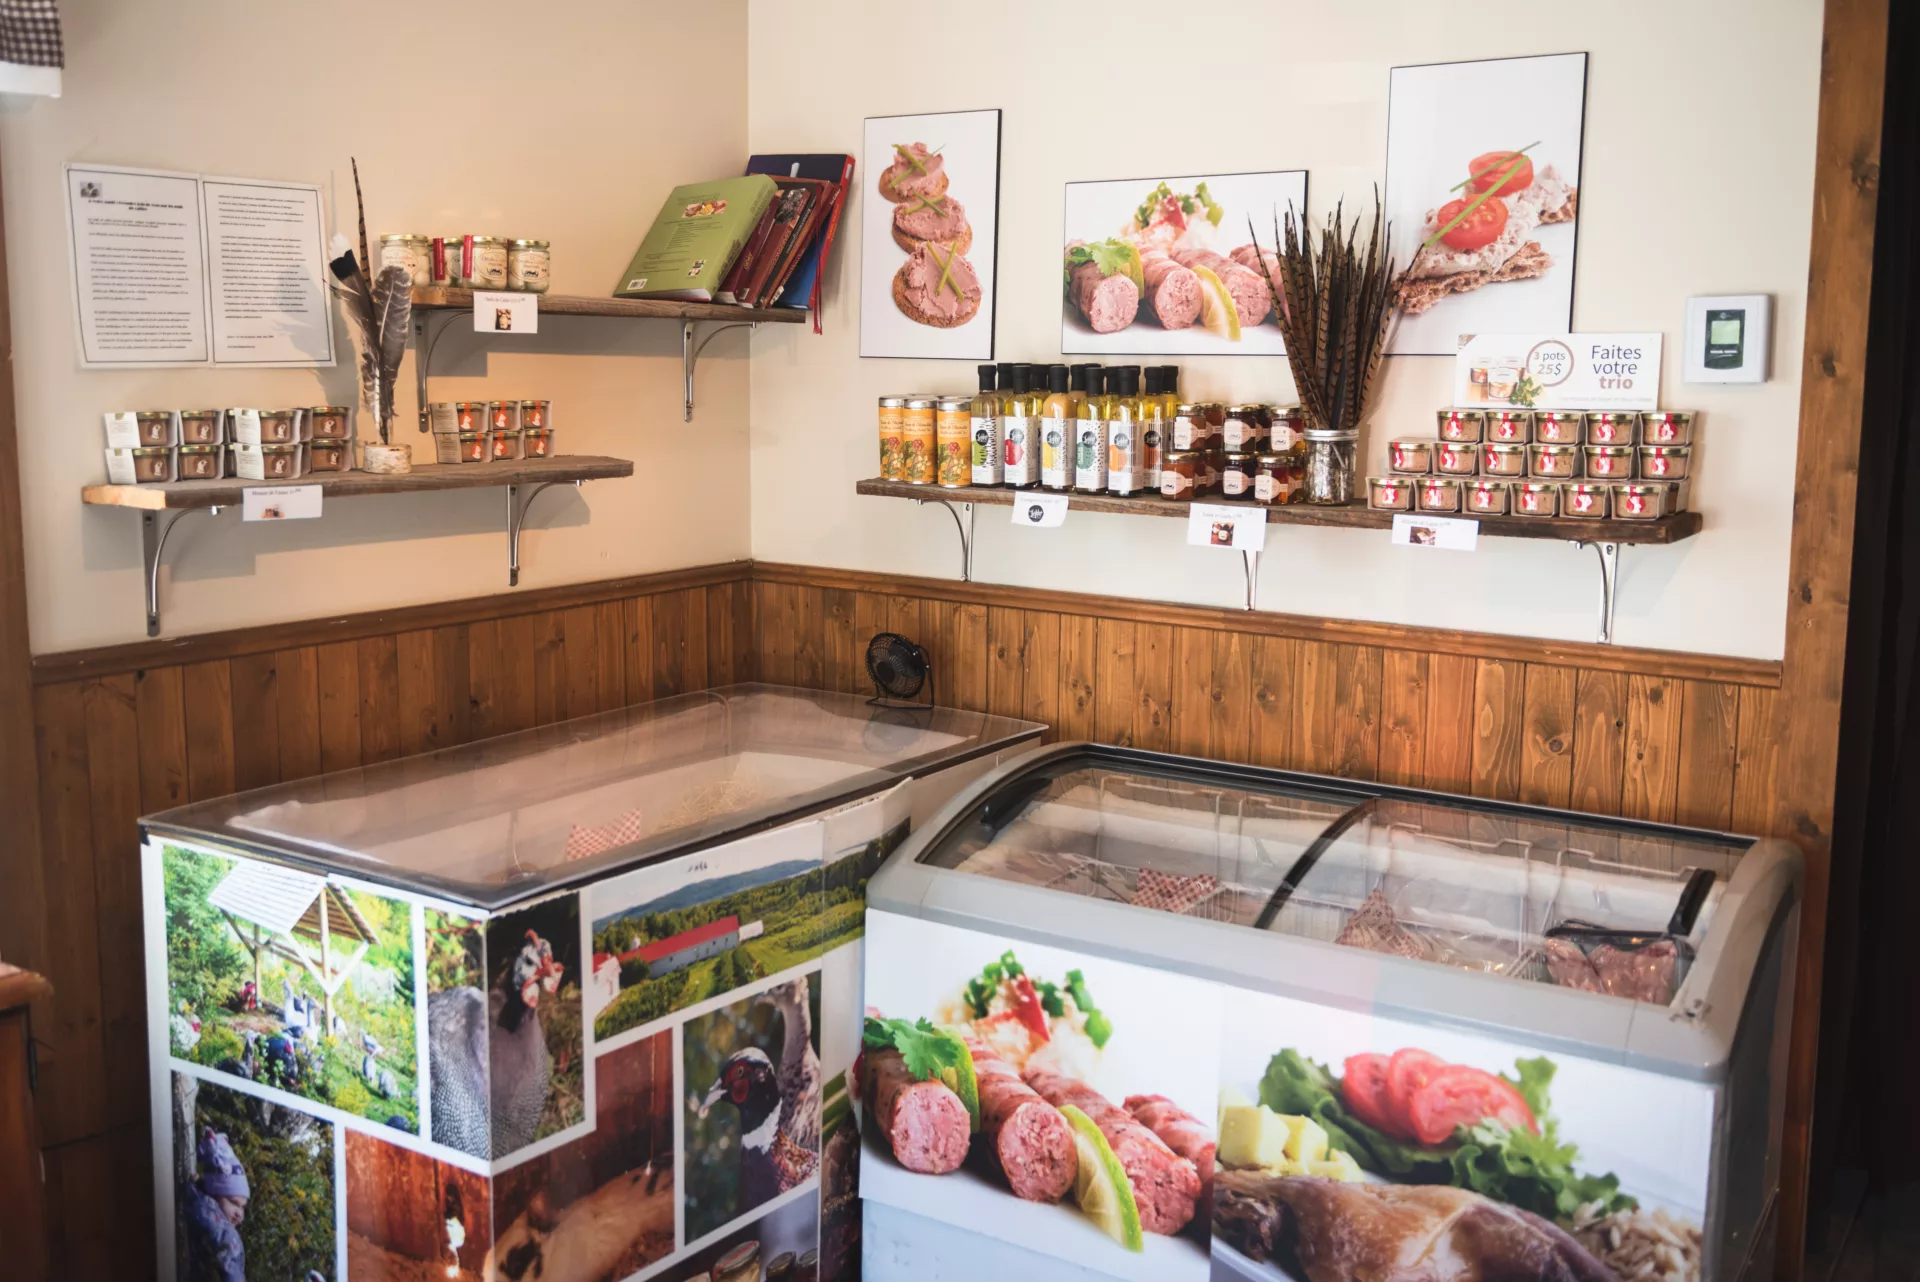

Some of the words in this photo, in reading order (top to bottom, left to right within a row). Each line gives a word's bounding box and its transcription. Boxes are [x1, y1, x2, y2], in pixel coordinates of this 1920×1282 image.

[1533, 351, 1540, 361] 3
[1542, 352, 1566, 362] pots
[1591, 345, 1642, 360] Faites
[1537, 362, 1562, 376] 25$
[1593, 362, 1638, 375] votre
[1598, 374, 1634, 389] trio
